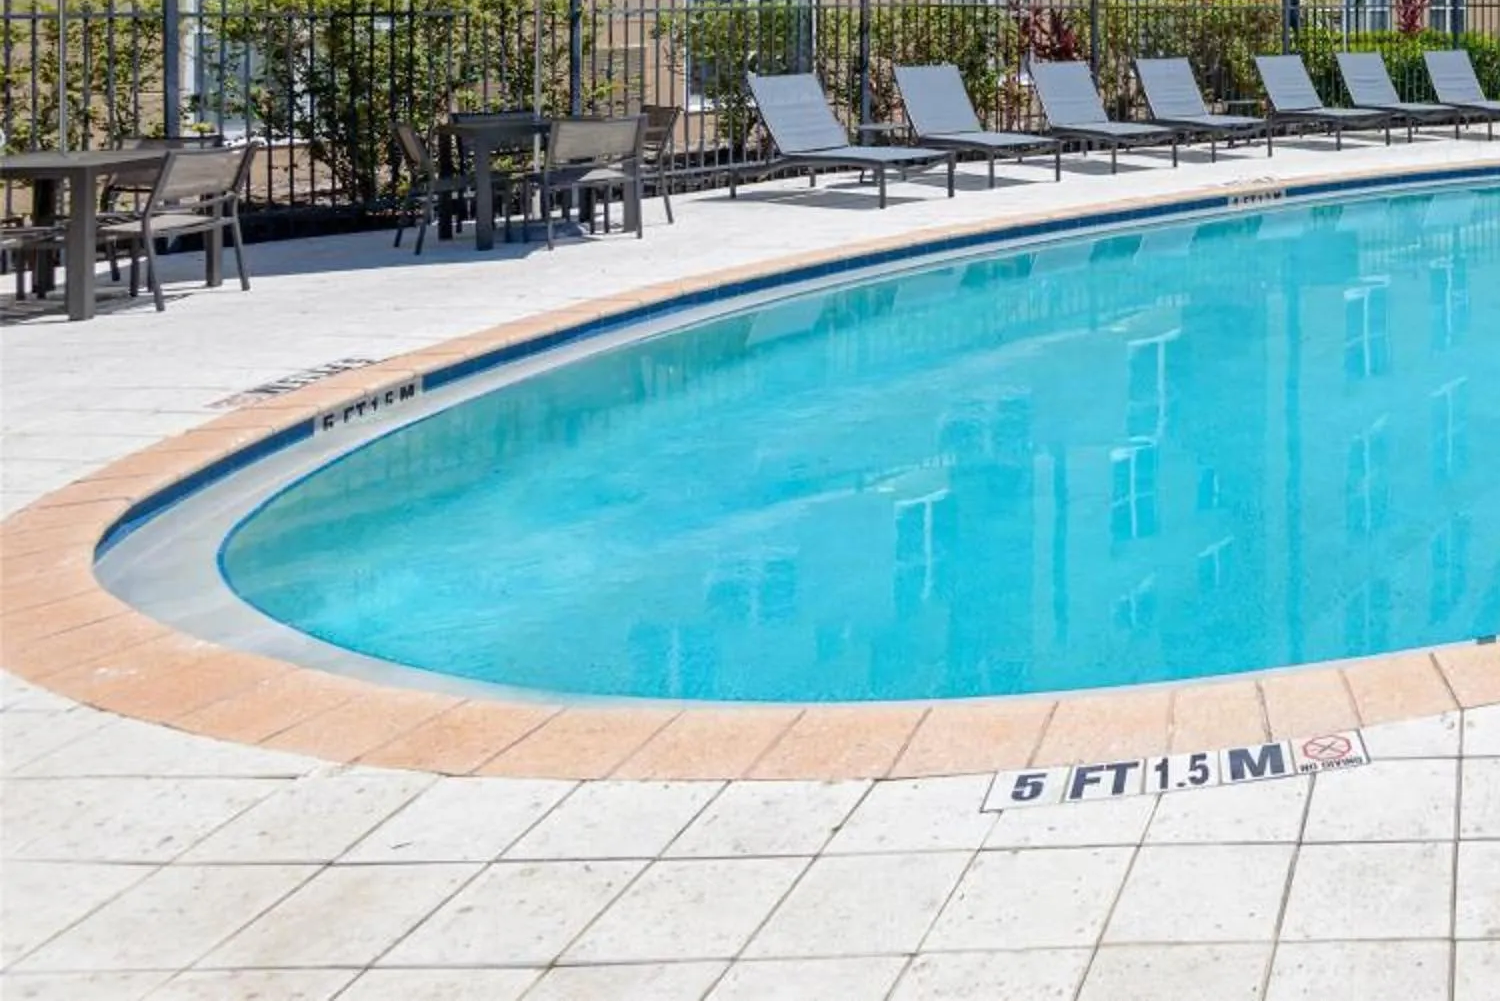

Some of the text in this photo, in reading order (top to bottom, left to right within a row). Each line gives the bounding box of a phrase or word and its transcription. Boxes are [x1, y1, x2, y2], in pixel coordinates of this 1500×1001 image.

[1011, 742, 1285, 801] 5 FT 1.5 M
